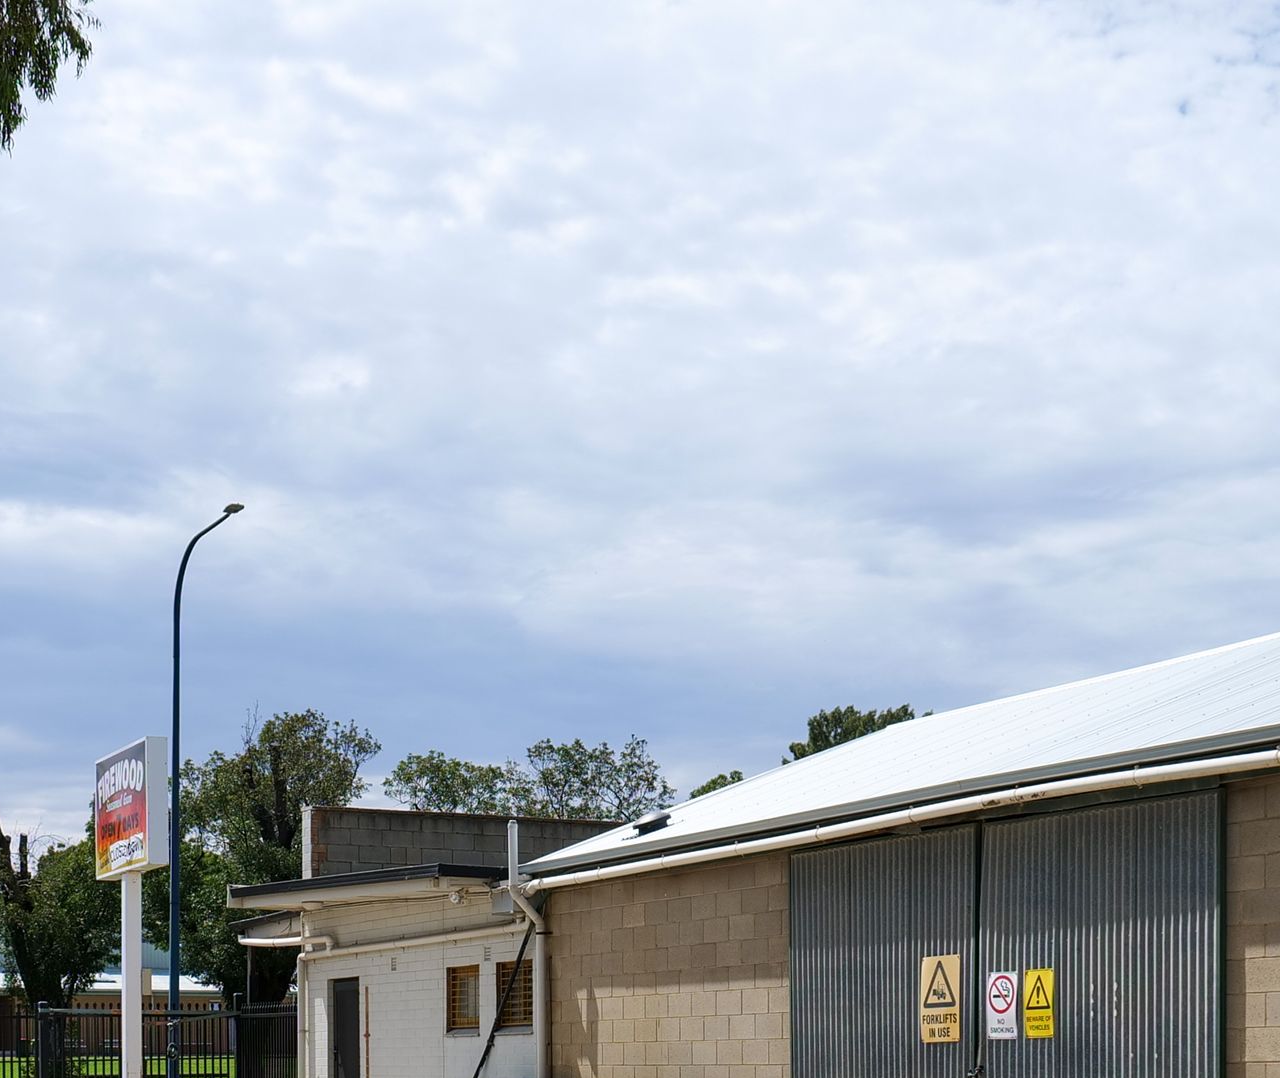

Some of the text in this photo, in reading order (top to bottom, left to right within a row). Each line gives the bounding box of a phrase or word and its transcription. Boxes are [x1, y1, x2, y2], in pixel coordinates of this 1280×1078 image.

[97, 758, 144, 810] FIREWOOD
[100, 822, 116, 840] OPEN
[122, 812, 140, 833] DAYS
[922, 1013, 958, 1025] FORKLIFTS
[1026, 1015, 1044, 1023] BEWARE
[929, 1027, 951, 1038] IN USE
[990, 1026, 1015, 1034] SMOKING
